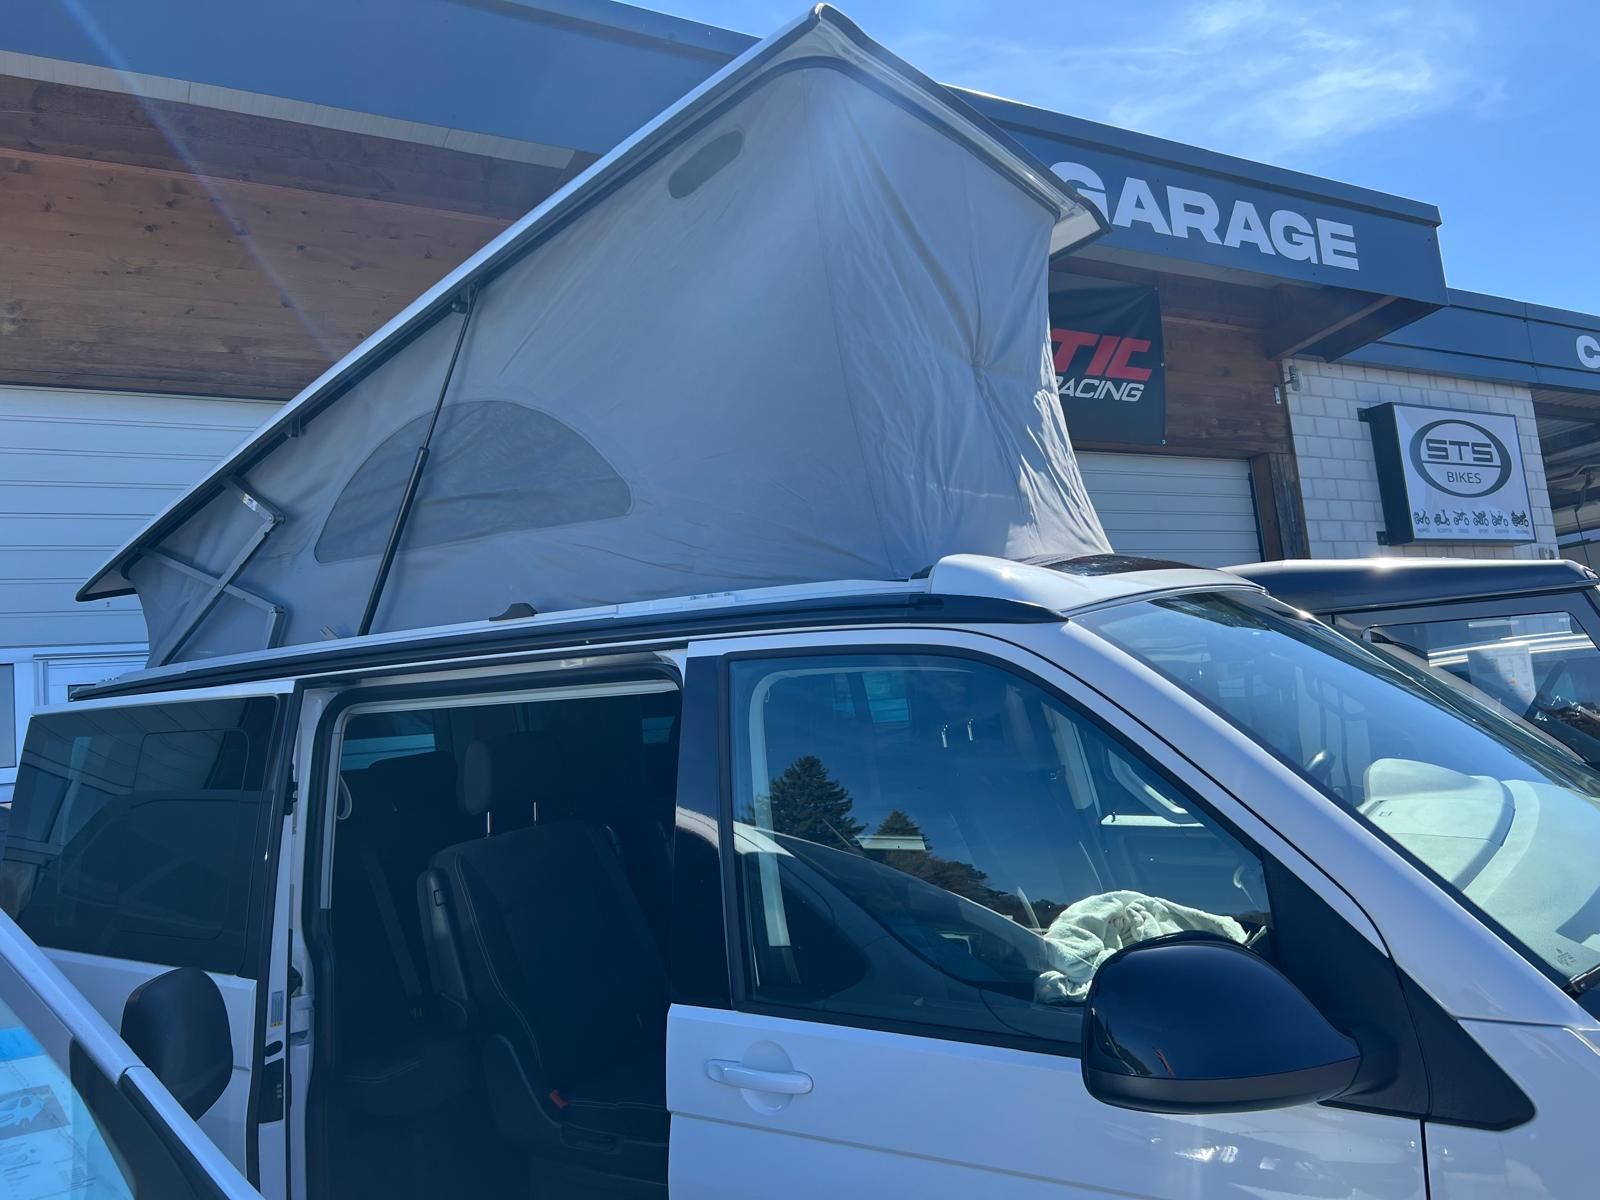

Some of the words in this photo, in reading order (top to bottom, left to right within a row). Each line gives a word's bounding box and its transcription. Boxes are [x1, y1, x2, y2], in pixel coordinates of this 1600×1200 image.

[1051, 328, 1152, 381] TIC
[1426, 438, 1493, 463] STS
[1446, 471, 1481, 484] BIKES
